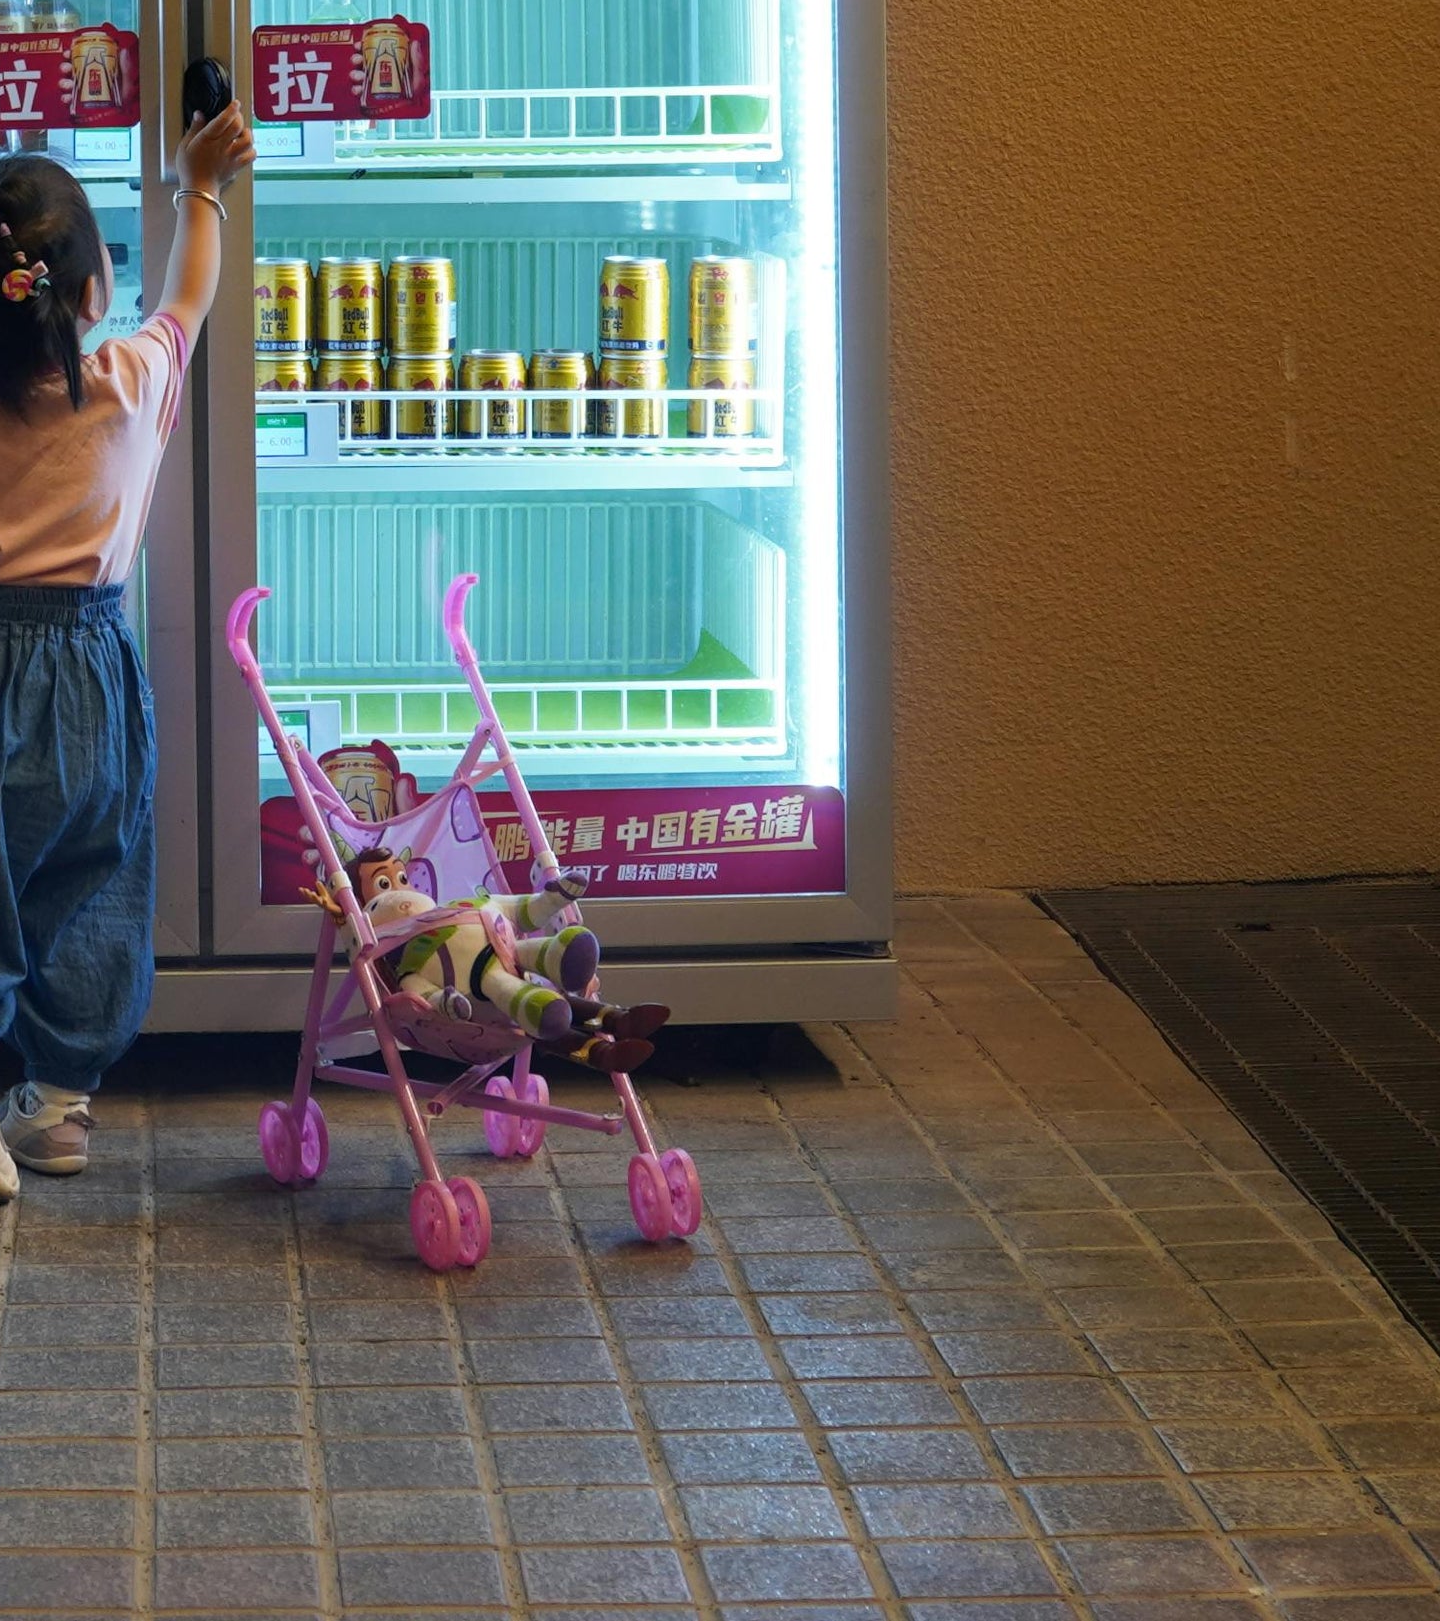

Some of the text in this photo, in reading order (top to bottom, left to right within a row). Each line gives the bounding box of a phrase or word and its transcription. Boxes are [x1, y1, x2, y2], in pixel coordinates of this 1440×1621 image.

[269, 50, 334, 116] 拉
[490, 794, 805, 862] 鹏能量 中国有金罐
[617, 862, 718, 882] 喝东鹏特饮
